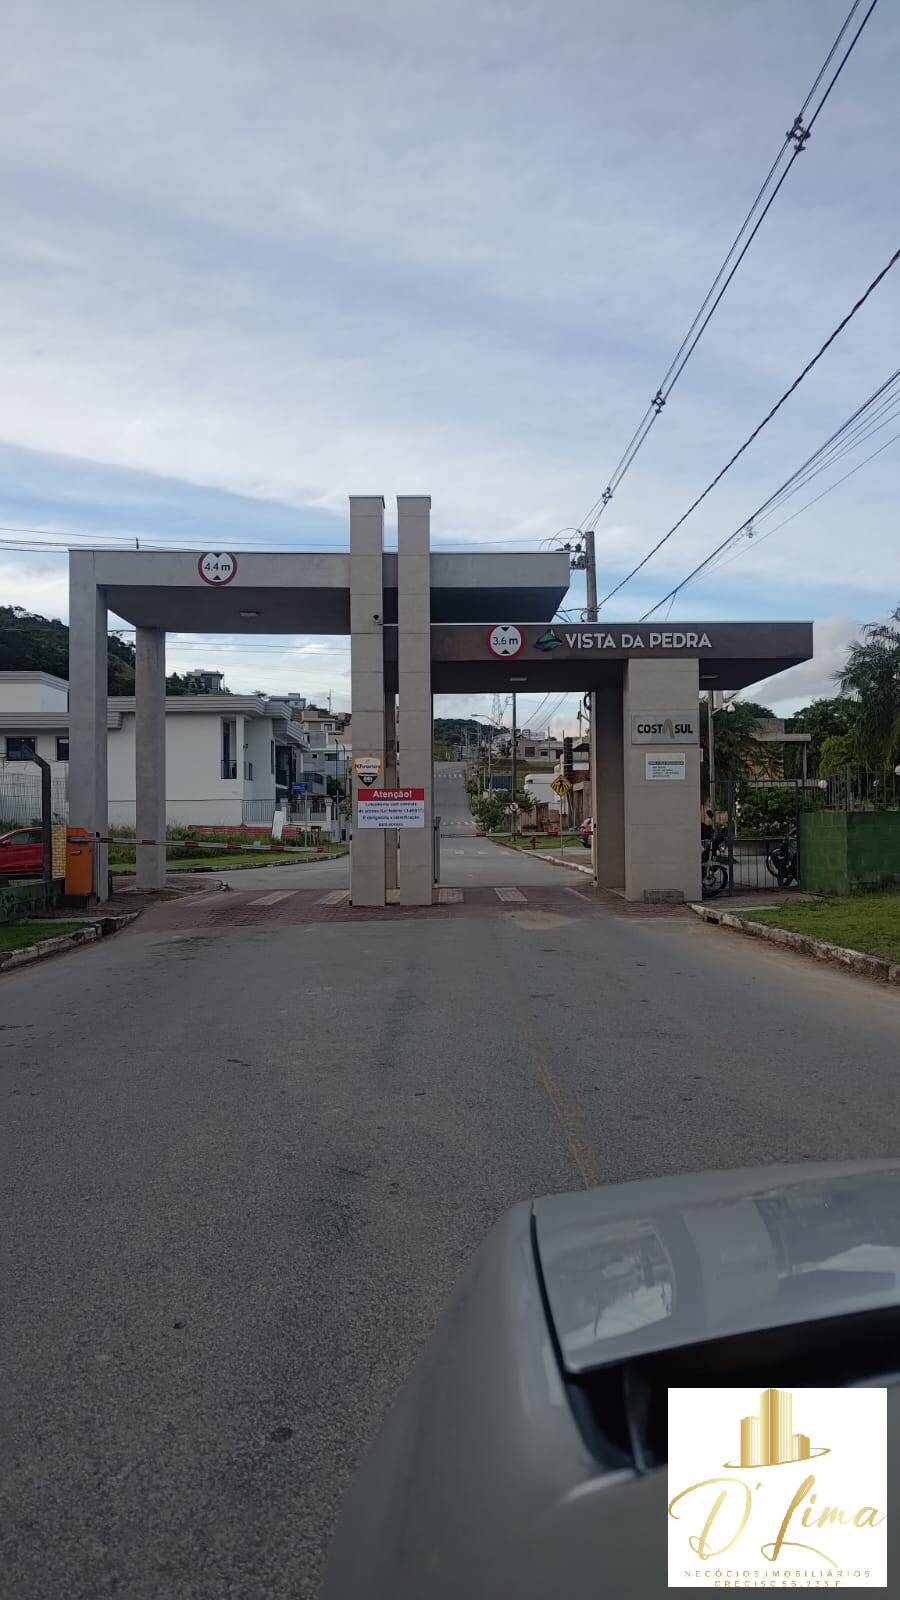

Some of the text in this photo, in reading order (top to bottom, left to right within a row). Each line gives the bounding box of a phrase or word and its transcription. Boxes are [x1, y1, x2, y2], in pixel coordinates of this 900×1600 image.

[492, 636, 519, 646] 3.6 m
[565, 632, 712, 649] VISTA DA PEDRA
[674, 724, 694, 734] SUL
